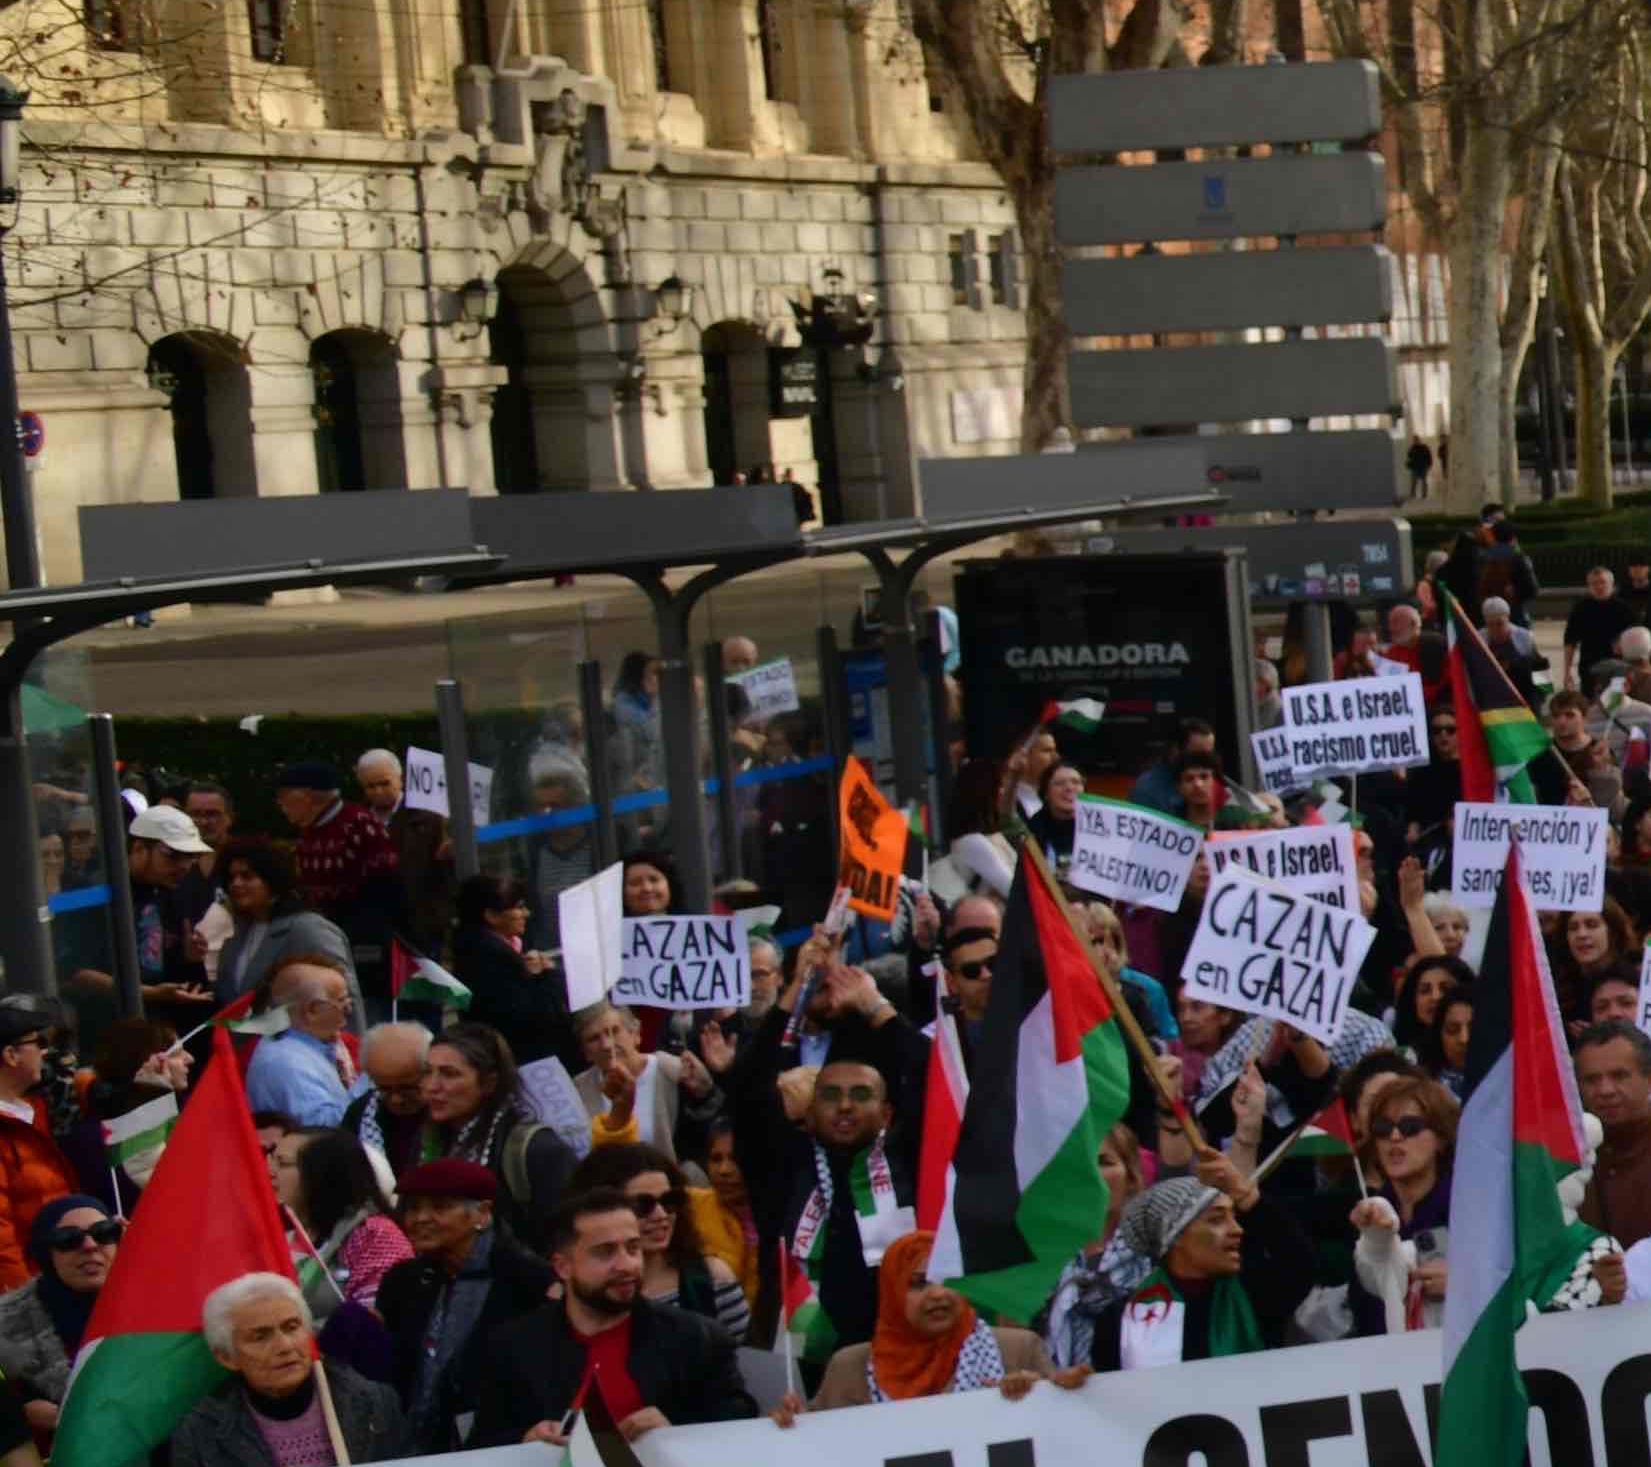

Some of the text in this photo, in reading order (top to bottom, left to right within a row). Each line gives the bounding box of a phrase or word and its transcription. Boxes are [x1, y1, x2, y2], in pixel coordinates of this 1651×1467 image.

[1004, 641, 1190, 670] GANADORA
[1290, 685, 1414, 728] U.S.A. e Israel,
[1292, 727, 1418, 768] racismo cruel.
[408, 764, 433, 795] NO
[1114, 810, 1195, 857] ESTADO
[1585, 818, 1599, 855] y
[1077, 849, 1180, 897] PALESTINO!
[1279, 836, 1344, 878] Israel,
[1557, 867, 1597, 904] ¡ya!
[621, 920, 736, 963] AZAN
[1210, 882, 1353, 969] CAZAN
[649, 958, 744, 1005] GAZA!
[1193, 954, 1345, 1037] en GAZA!
